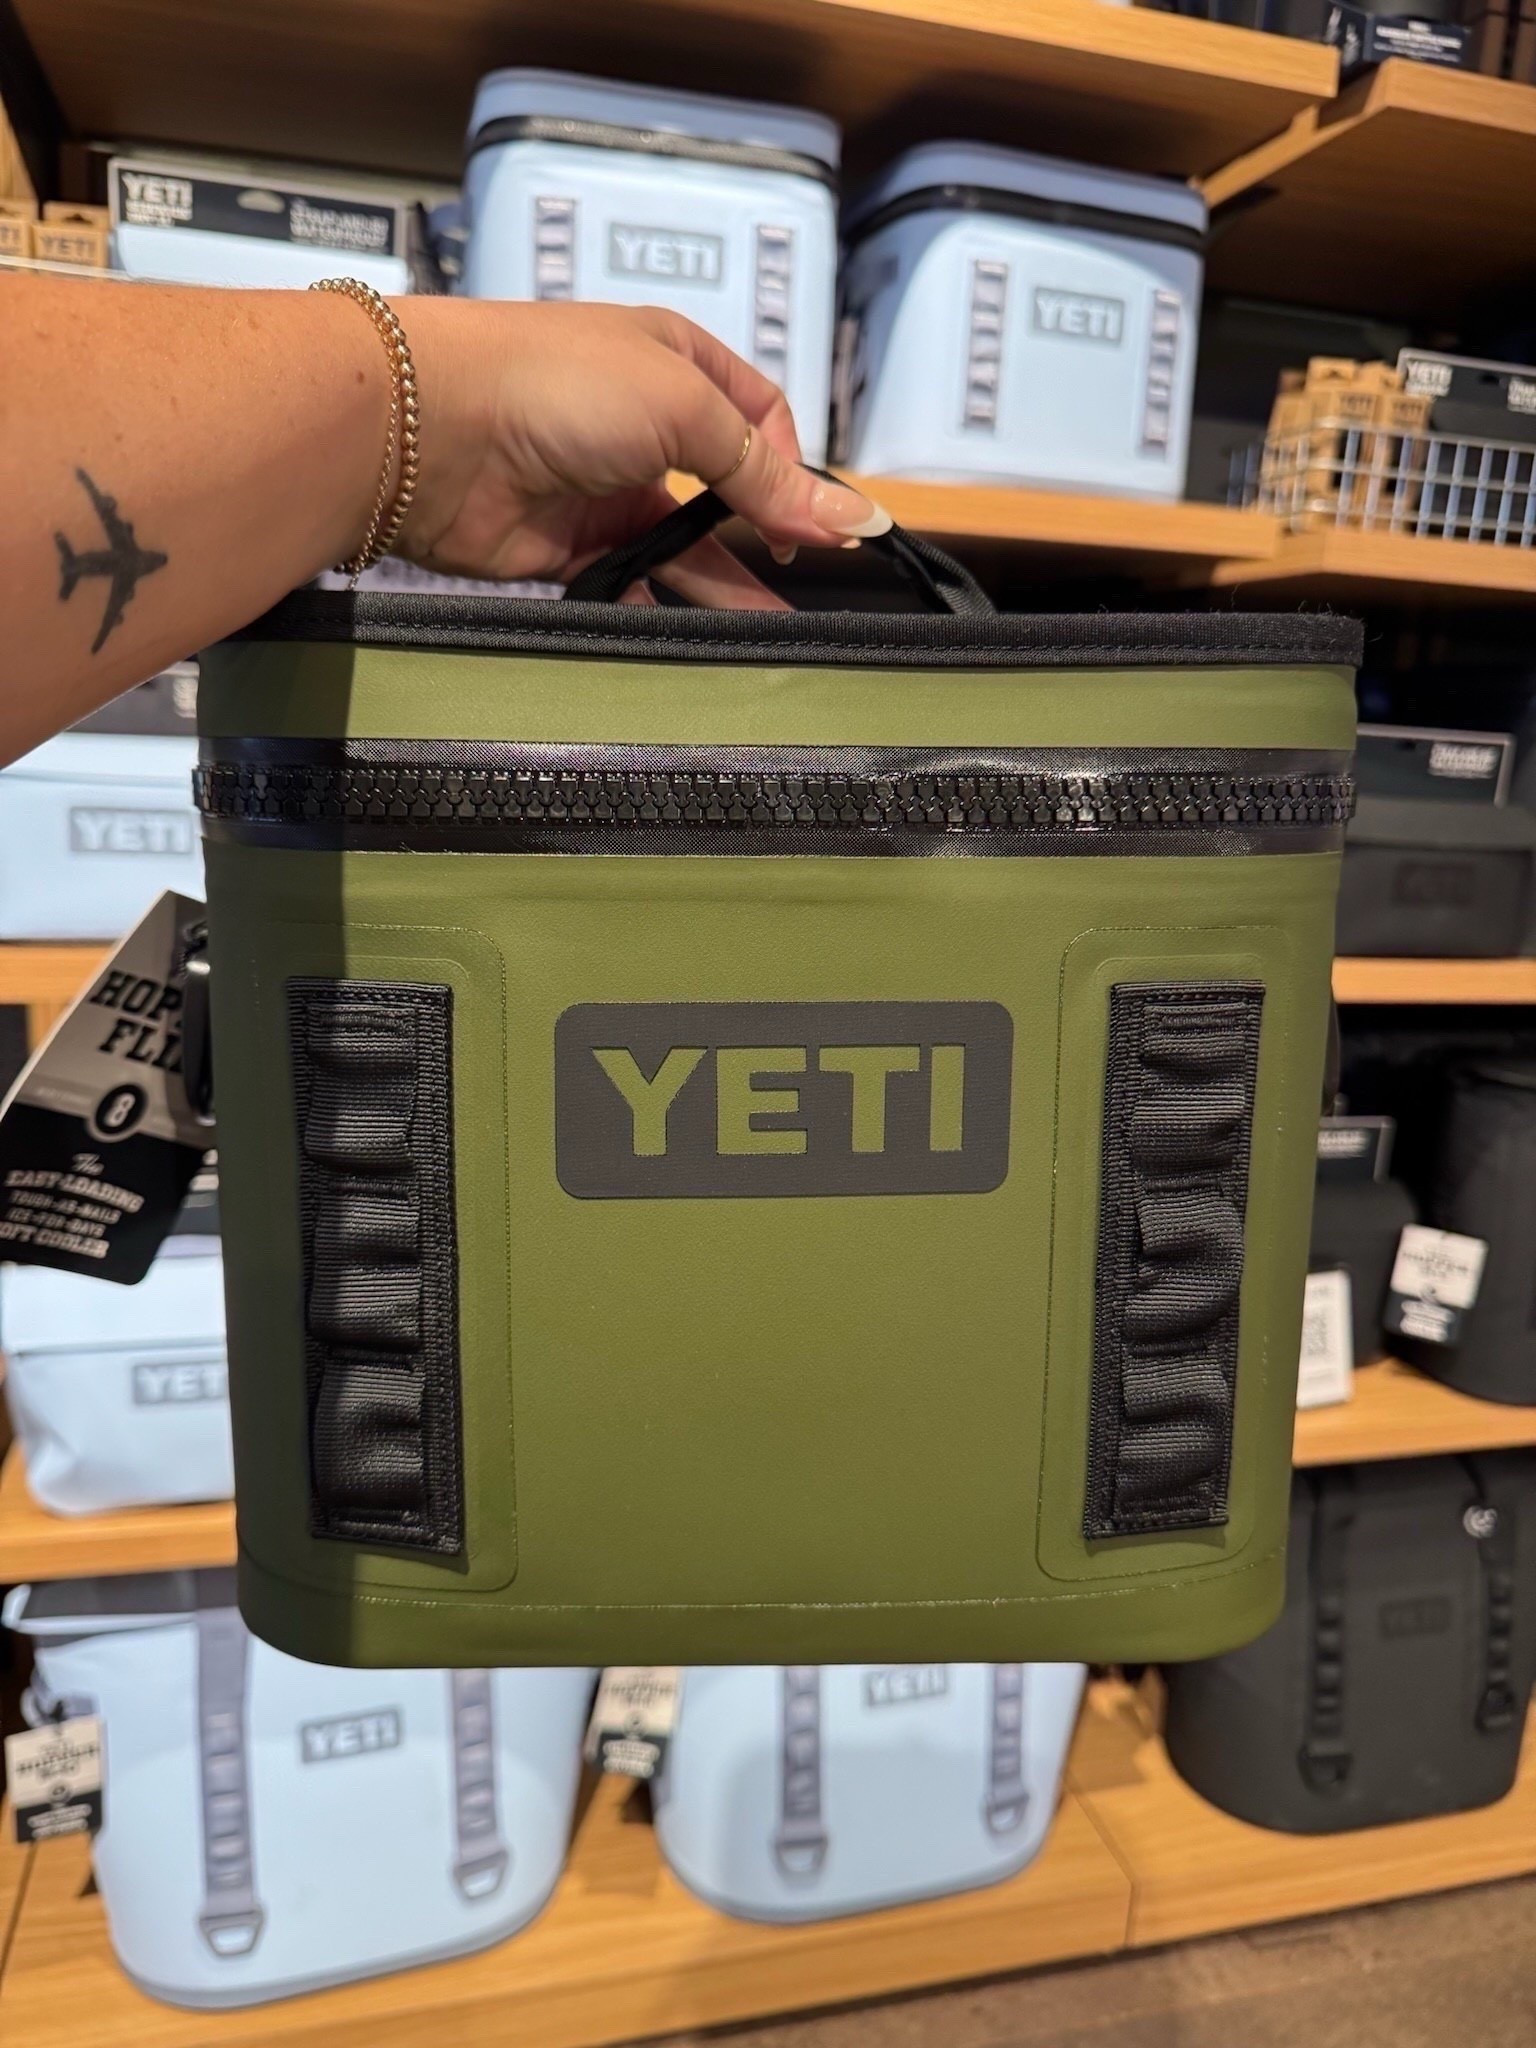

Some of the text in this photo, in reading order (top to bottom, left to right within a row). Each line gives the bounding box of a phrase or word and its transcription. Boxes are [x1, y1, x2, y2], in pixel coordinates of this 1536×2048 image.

[122, 172, 193, 207] YETI
[40, 235, 96, 255] YETI
[613, 230, 719, 280] YETI
[1036, 297, 1121, 340] YETI
[73, 811, 190, 851] YETI
[90, 970, 183, 1028] HOP
[105, 1093, 136, 1128] 8
[591, 1043, 966, 1156] YETI
[0, 1221, 37, 1242] OFT
[138, 1365, 226, 1403] YET
[305, 1713, 397, 1758] YETI
